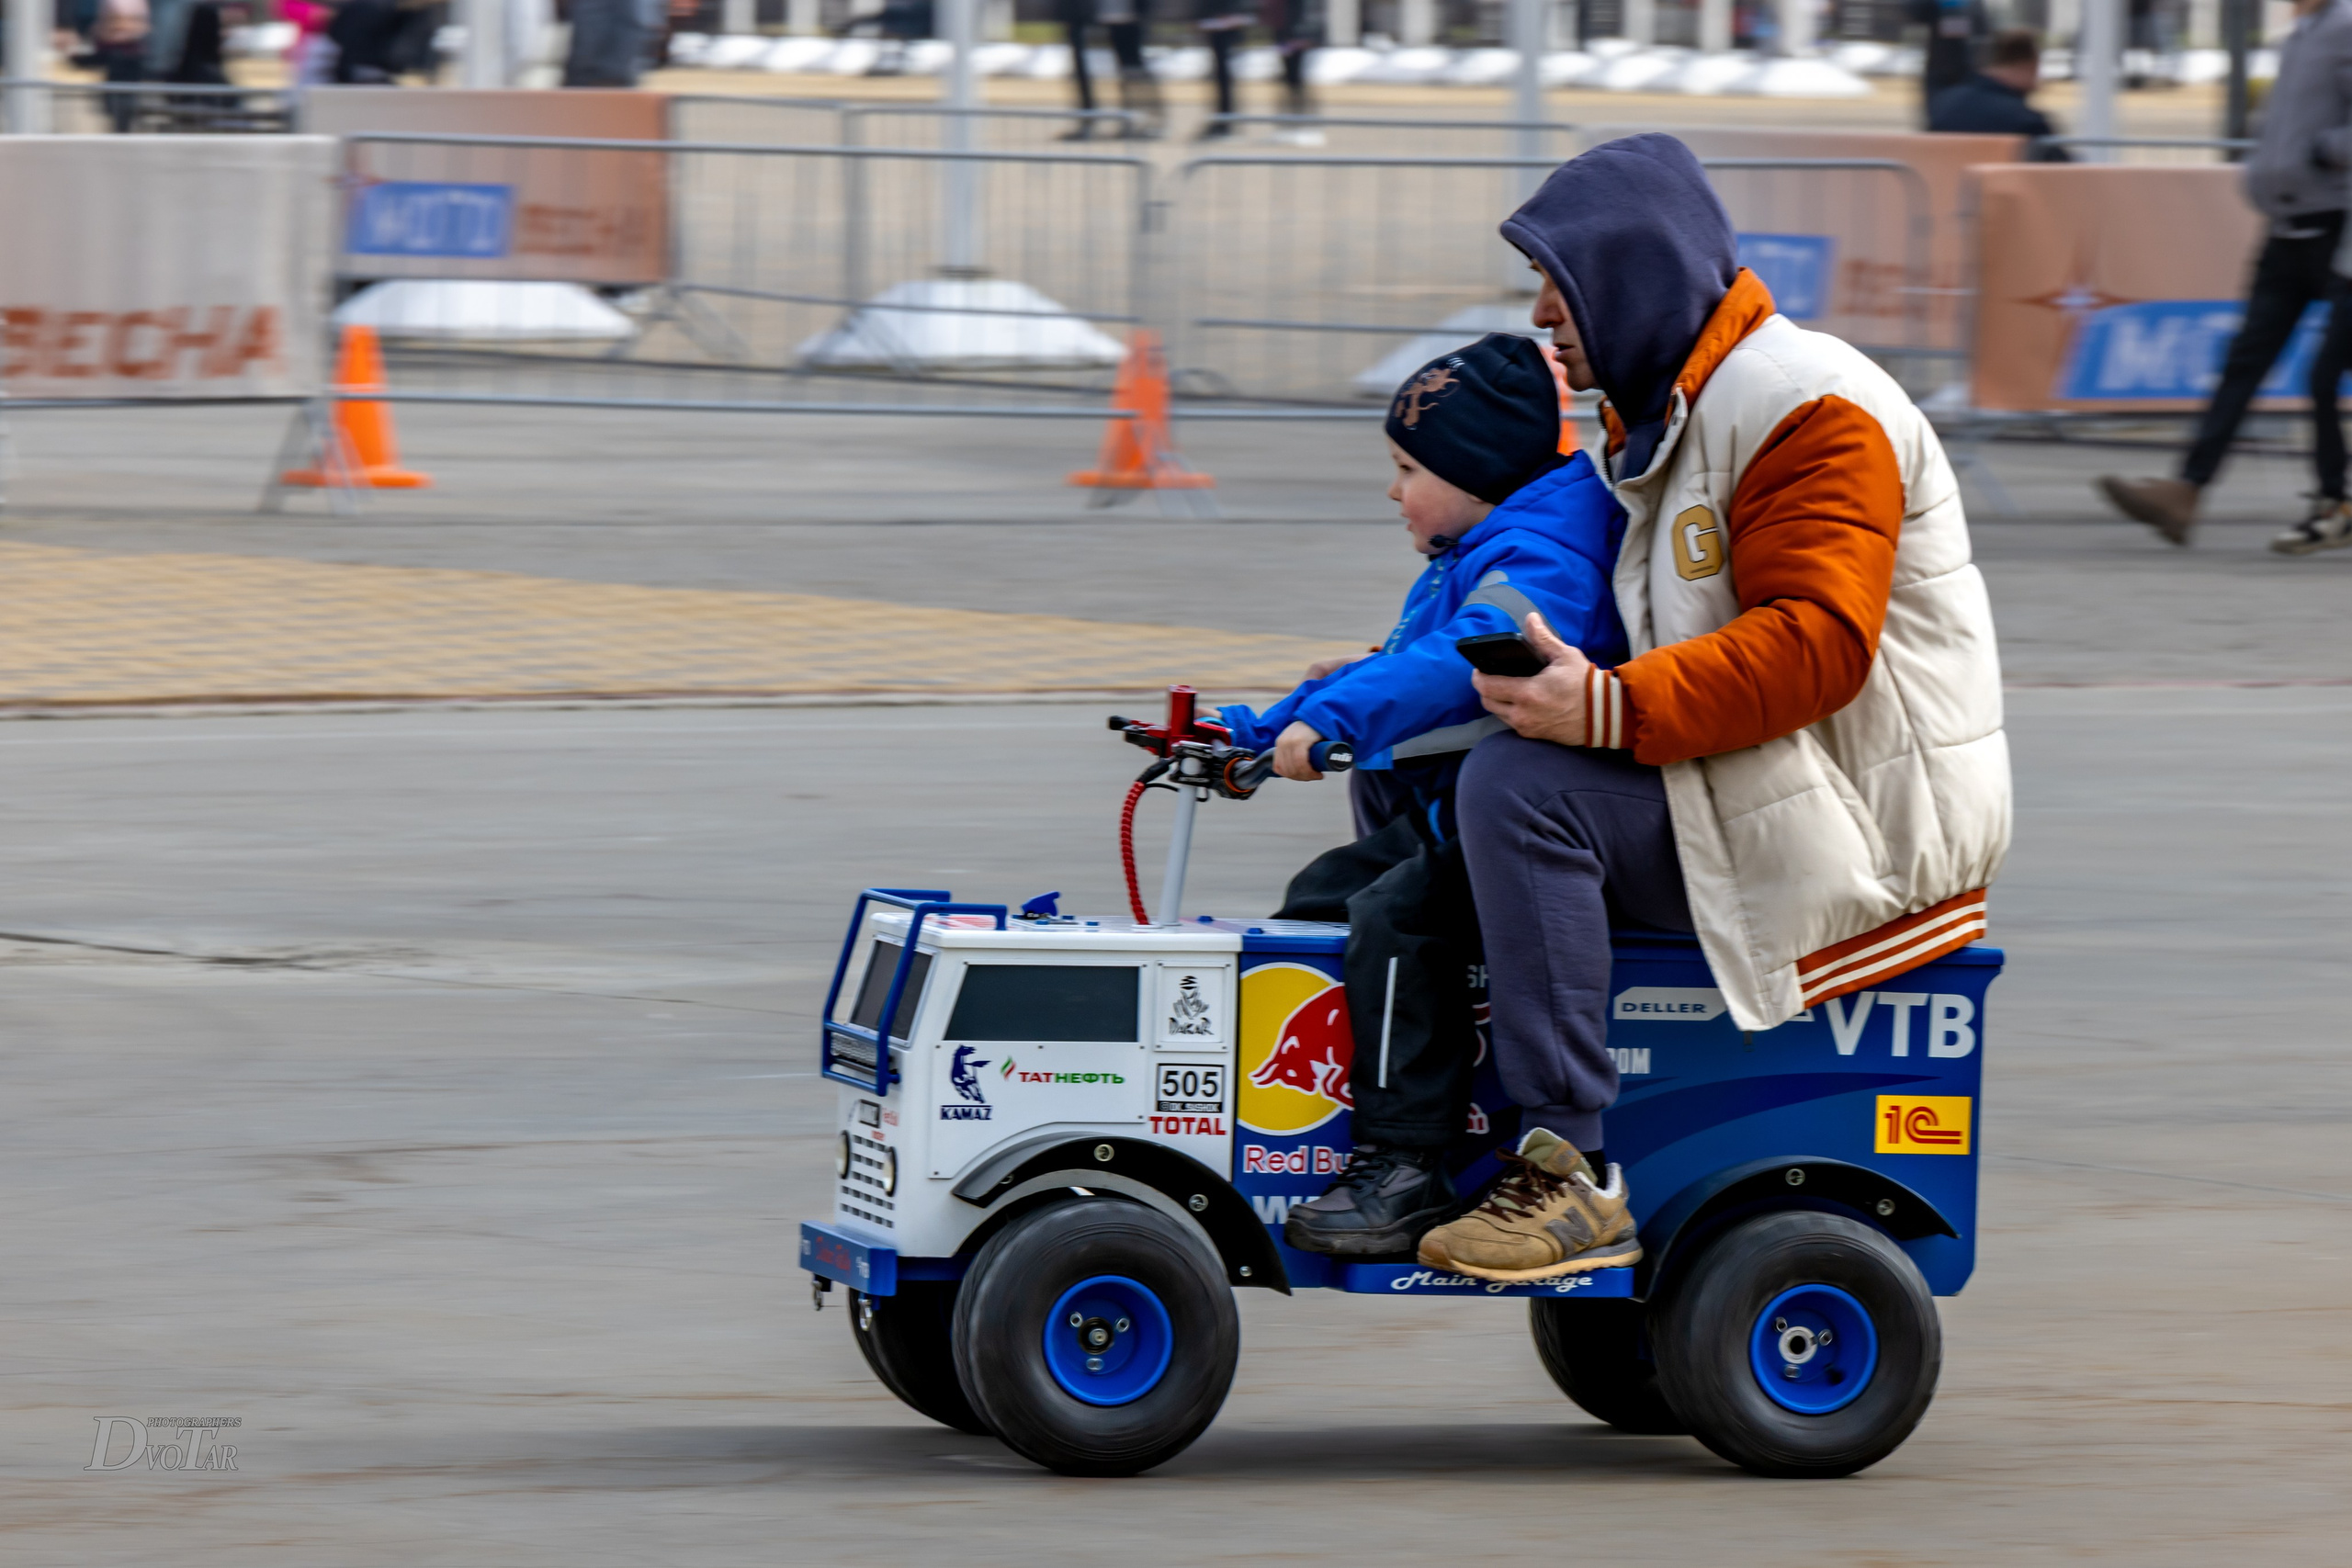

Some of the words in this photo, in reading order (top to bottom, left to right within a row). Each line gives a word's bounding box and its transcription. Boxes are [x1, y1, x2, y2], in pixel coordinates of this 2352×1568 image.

[1671, 504, 1724, 581] G
[1621, 1002, 1707, 1014] DELLER
[1825, 991, 1976, 1058] VTB
[1018, 1071, 1125, 1084] ТАТНЕФТЬ
[1161, 1070, 1218, 1098] 505
[940, 1108, 992, 1120] KAMAZ
[1148, 1116, 1227, 1135] TOTAL
[1243, 1145, 1309, 1174] Red
[1312, 1145, 1357, 1174] Bu
[1390, 1271, 1477, 1290] Main
